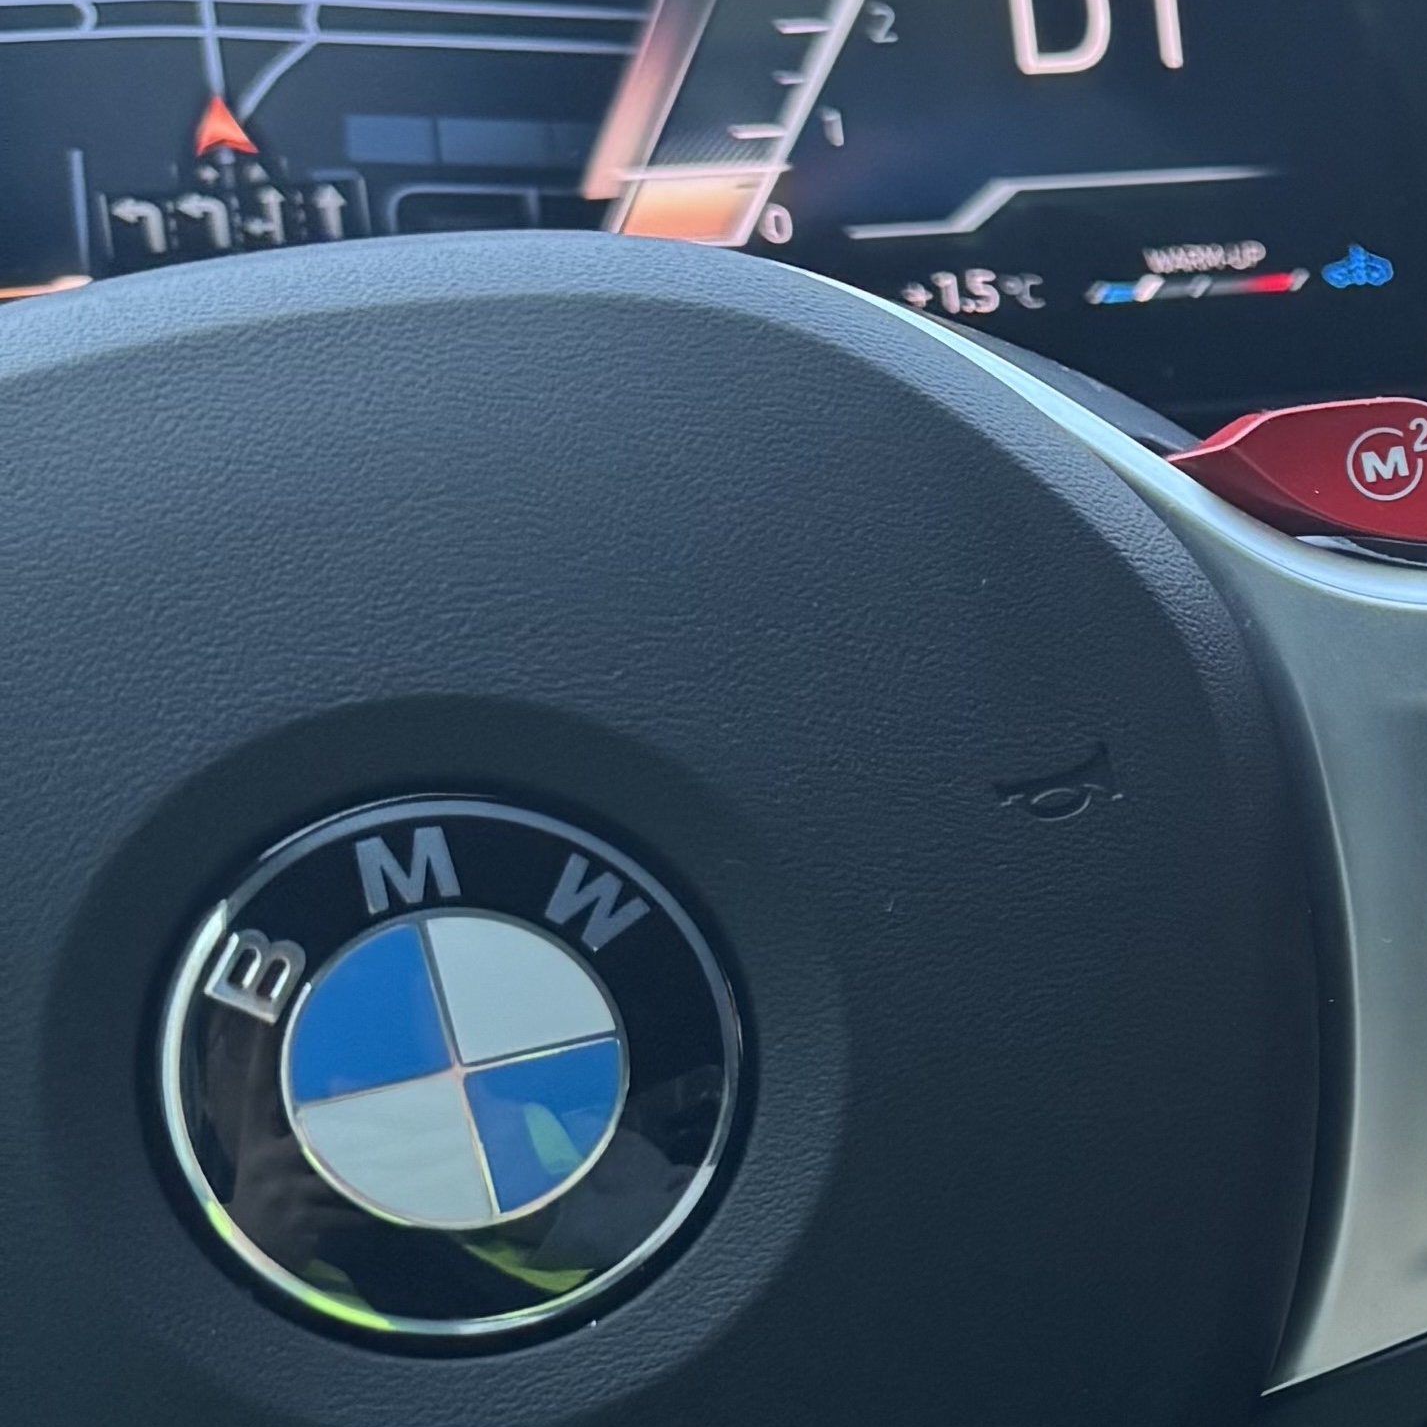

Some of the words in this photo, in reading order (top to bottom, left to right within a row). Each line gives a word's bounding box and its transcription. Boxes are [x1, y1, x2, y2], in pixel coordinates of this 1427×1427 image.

[863, 1, 898, 43] 2
[819, 107, 844, 146] 1
[762, 203, 793, 243] 0
[203, 825, 651, 1025] BMW
